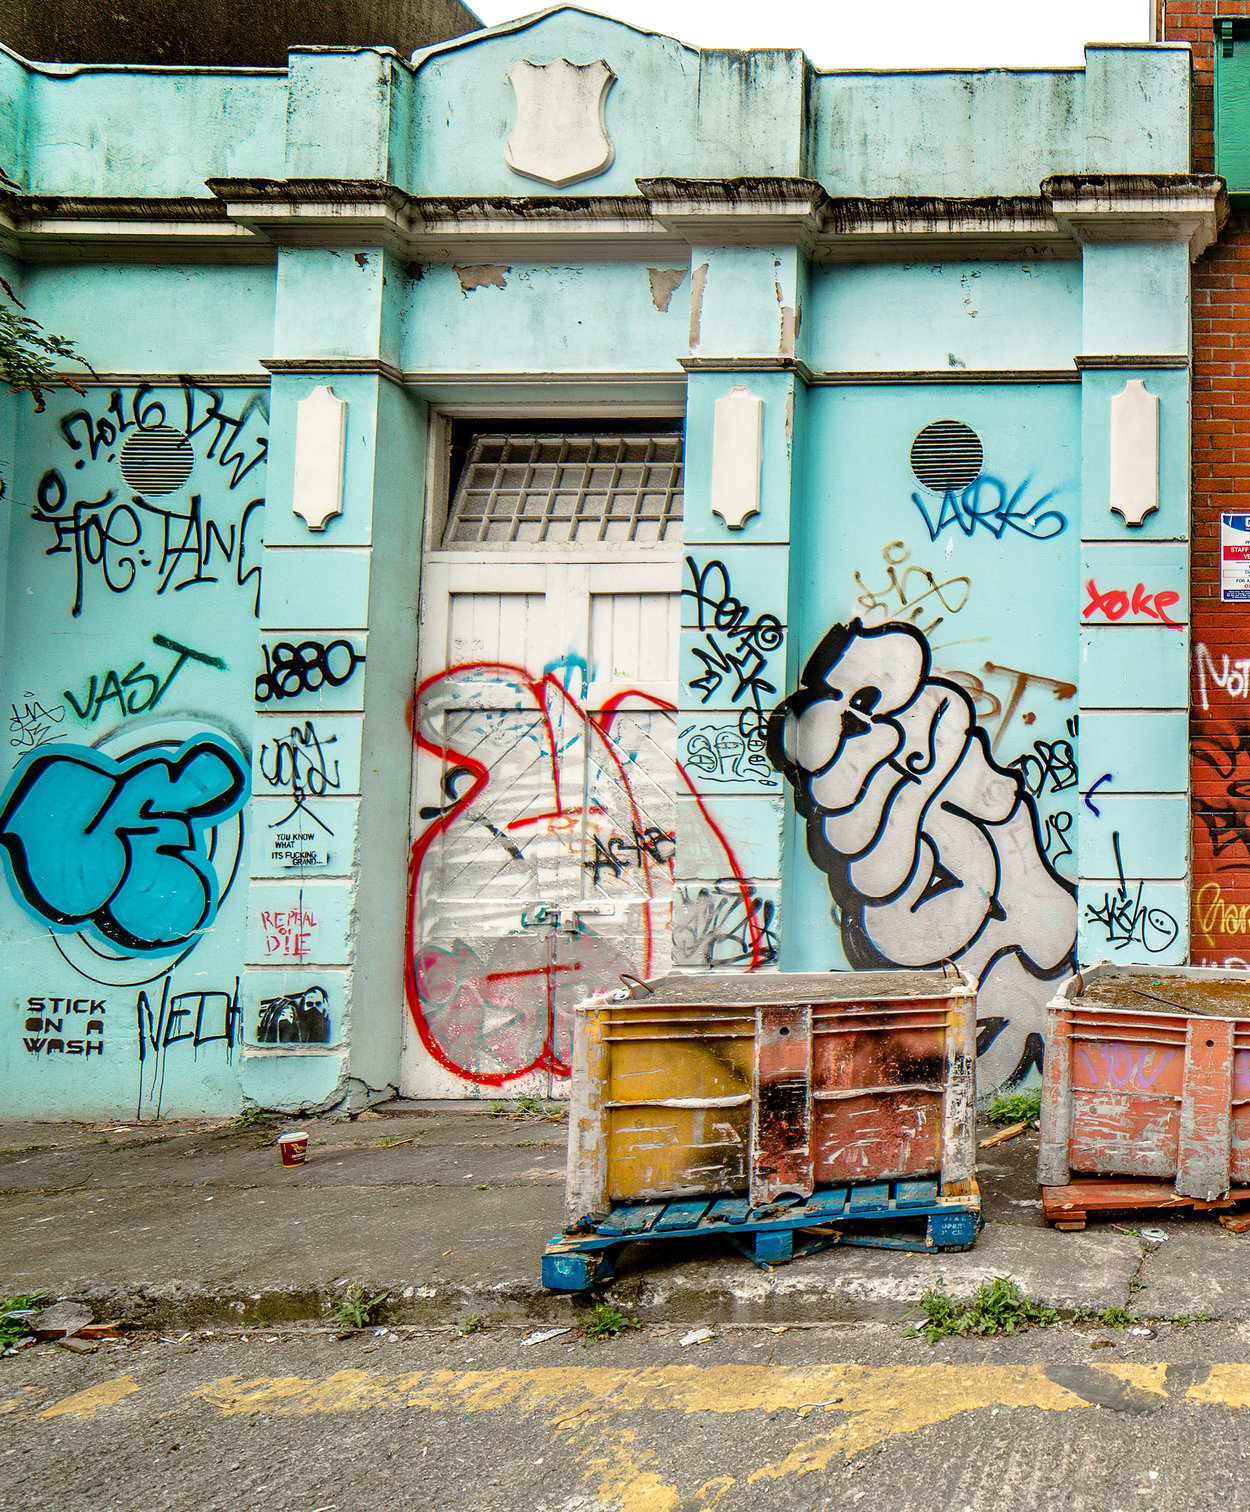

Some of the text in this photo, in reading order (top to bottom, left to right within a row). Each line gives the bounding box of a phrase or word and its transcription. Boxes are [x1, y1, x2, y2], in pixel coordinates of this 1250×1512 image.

[276, 833, 315, 841] YOU KNOW
[271, 851, 317, 859] ITS FUCKING
[27, 997, 107, 1015] STICK
[25, 1017, 104, 1035] ON A
[23, 1037, 104, 1055] WASH
